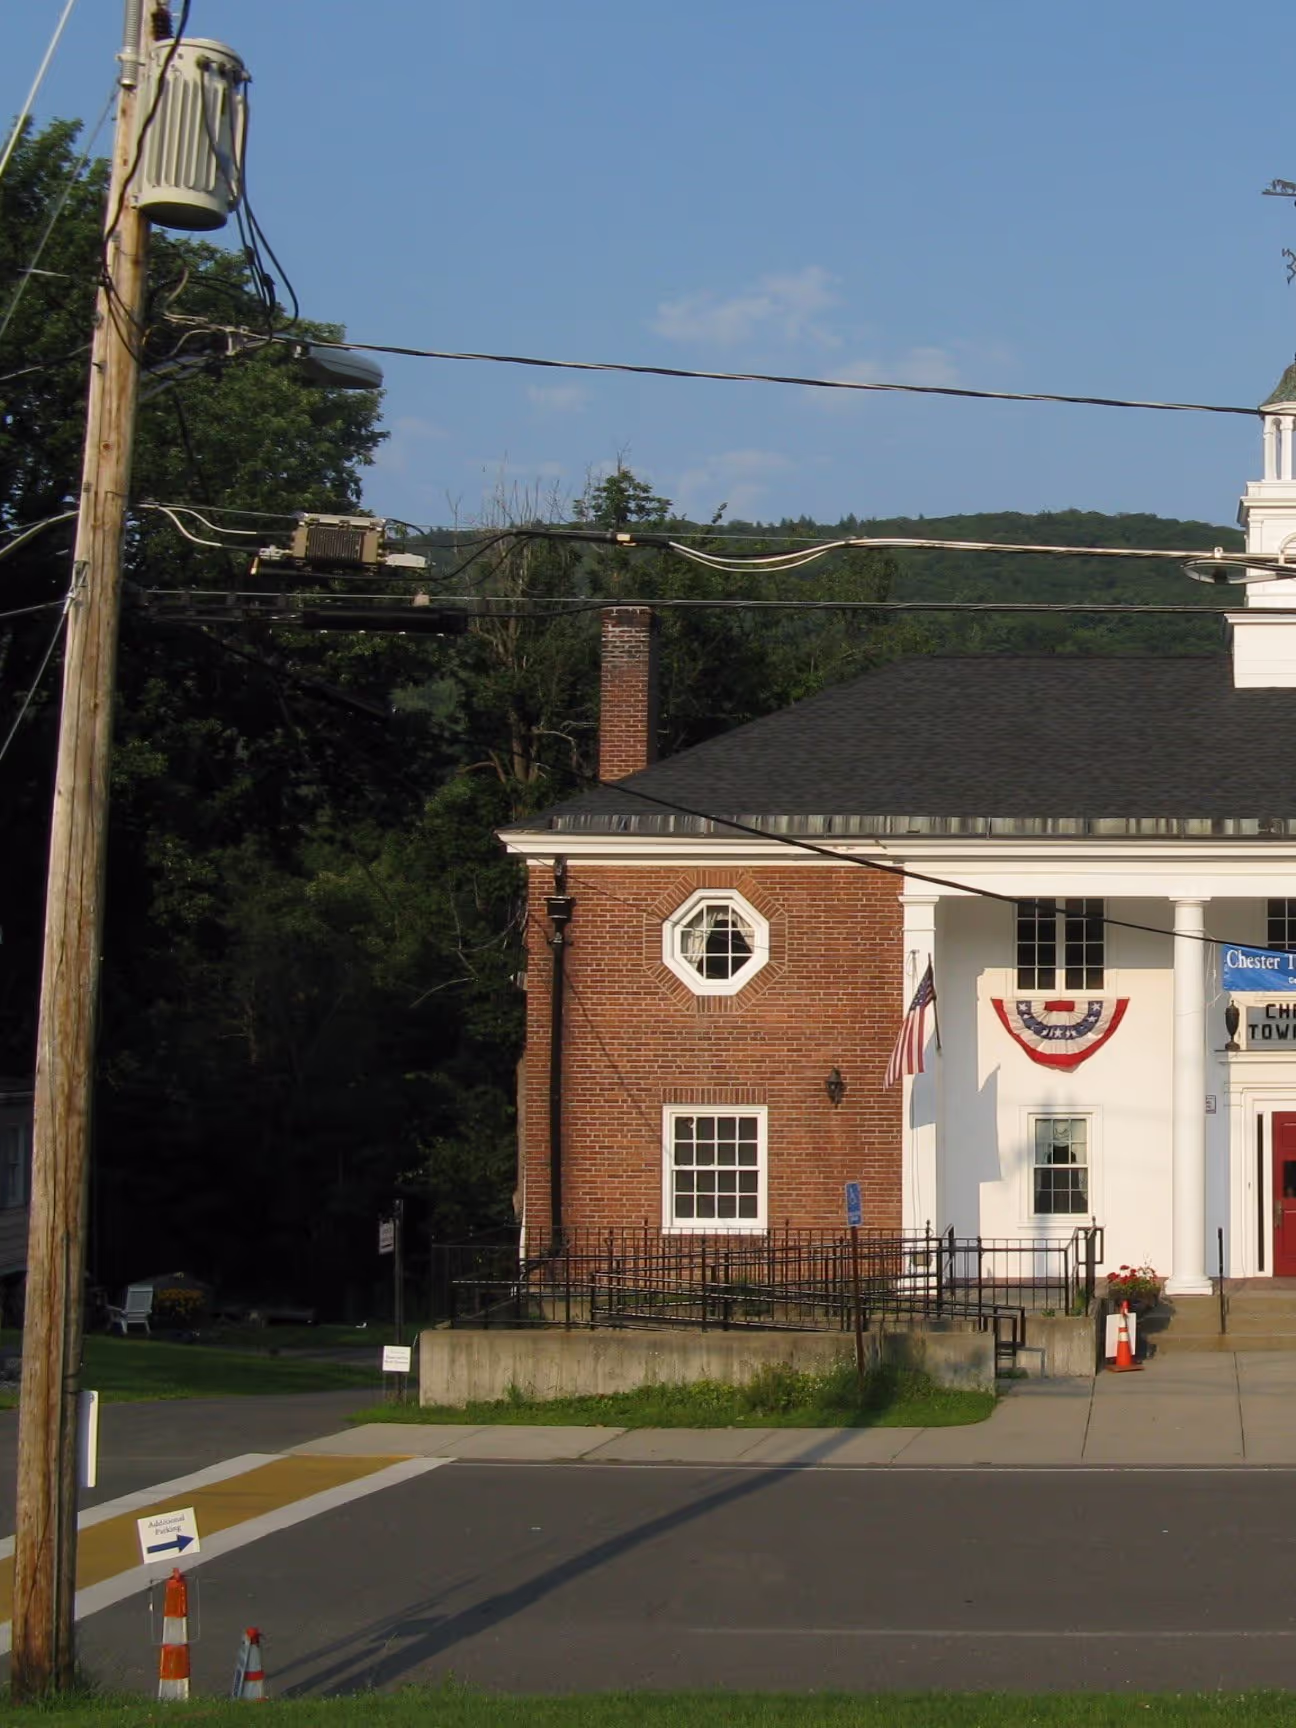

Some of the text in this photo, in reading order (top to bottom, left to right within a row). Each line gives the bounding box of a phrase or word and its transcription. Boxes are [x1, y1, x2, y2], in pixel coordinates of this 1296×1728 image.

[1226, 949, 1281, 970] Chester
[148, 1513, 185, 1528] Additional
[155, 1525, 182, 1535] Parking
